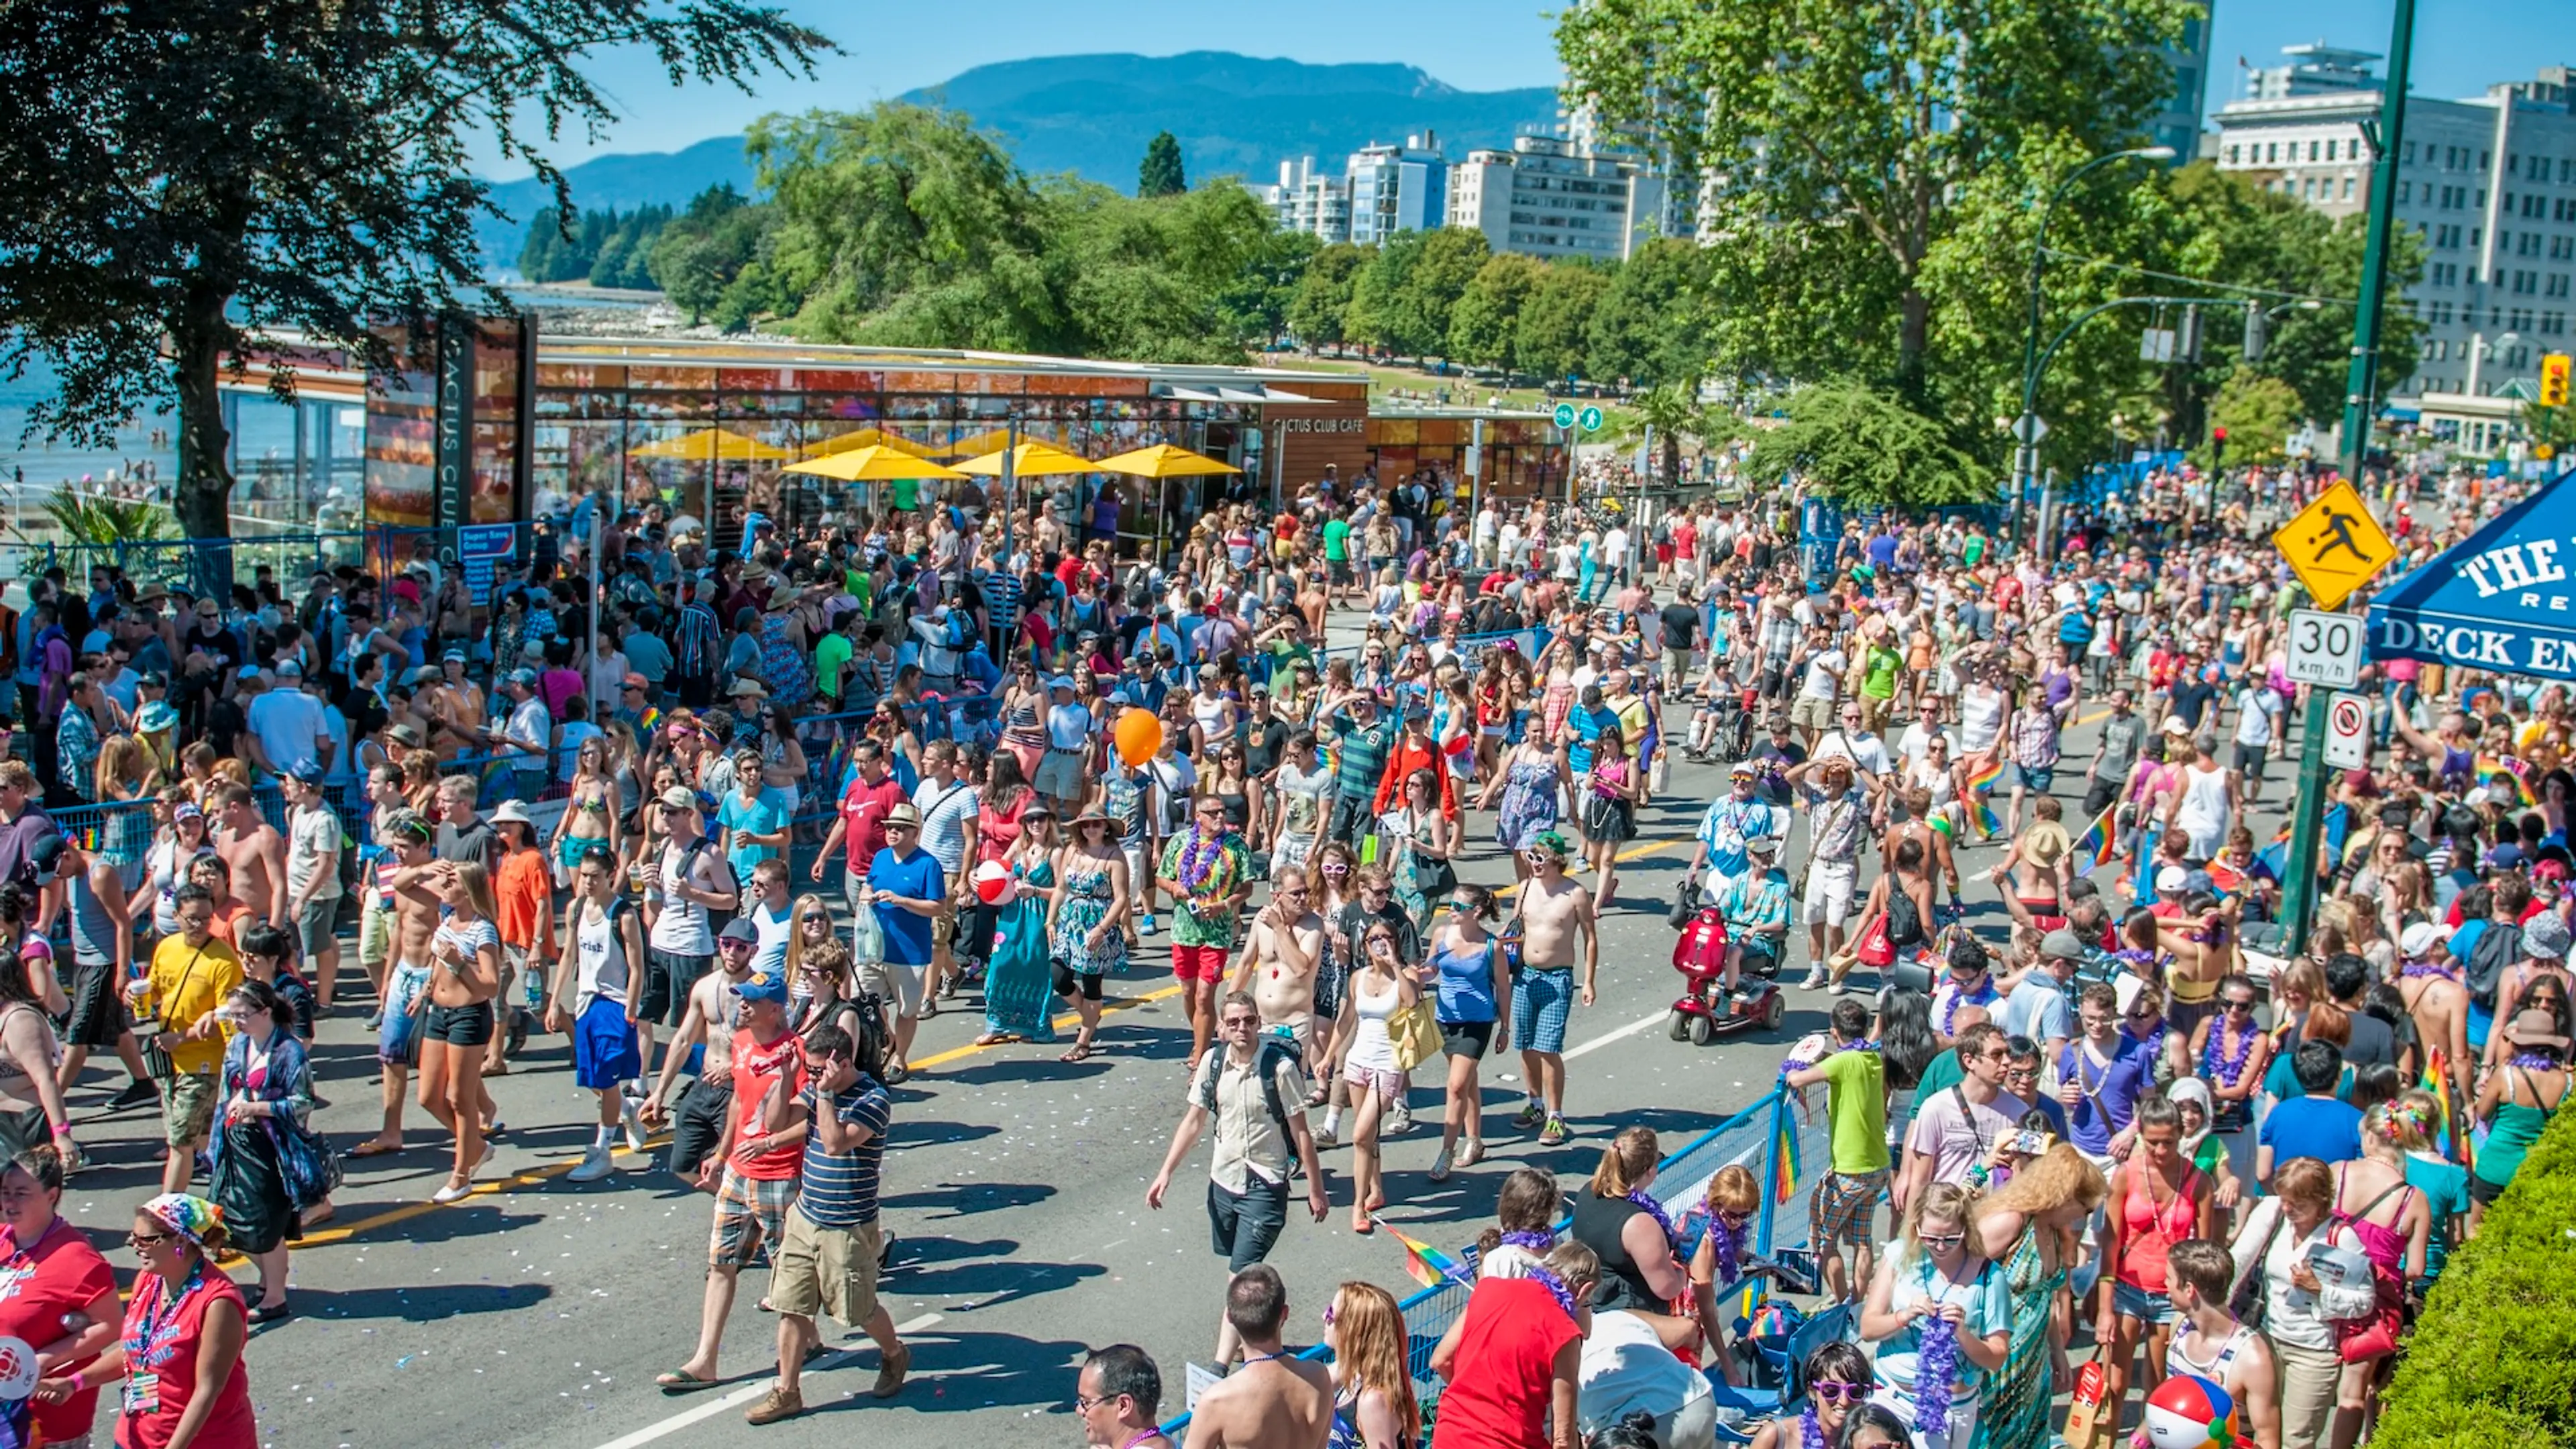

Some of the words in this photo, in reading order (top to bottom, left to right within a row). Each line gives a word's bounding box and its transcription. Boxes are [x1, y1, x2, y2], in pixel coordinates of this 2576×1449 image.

[1314, 418, 1337, 433] CLUB
[2457, 539, 2566, 598] THE
[2298, 621, 2351, 657] 30
[2380, 617, 2516, 666] DECK
[2298, 660, 2345, 678] km/h
